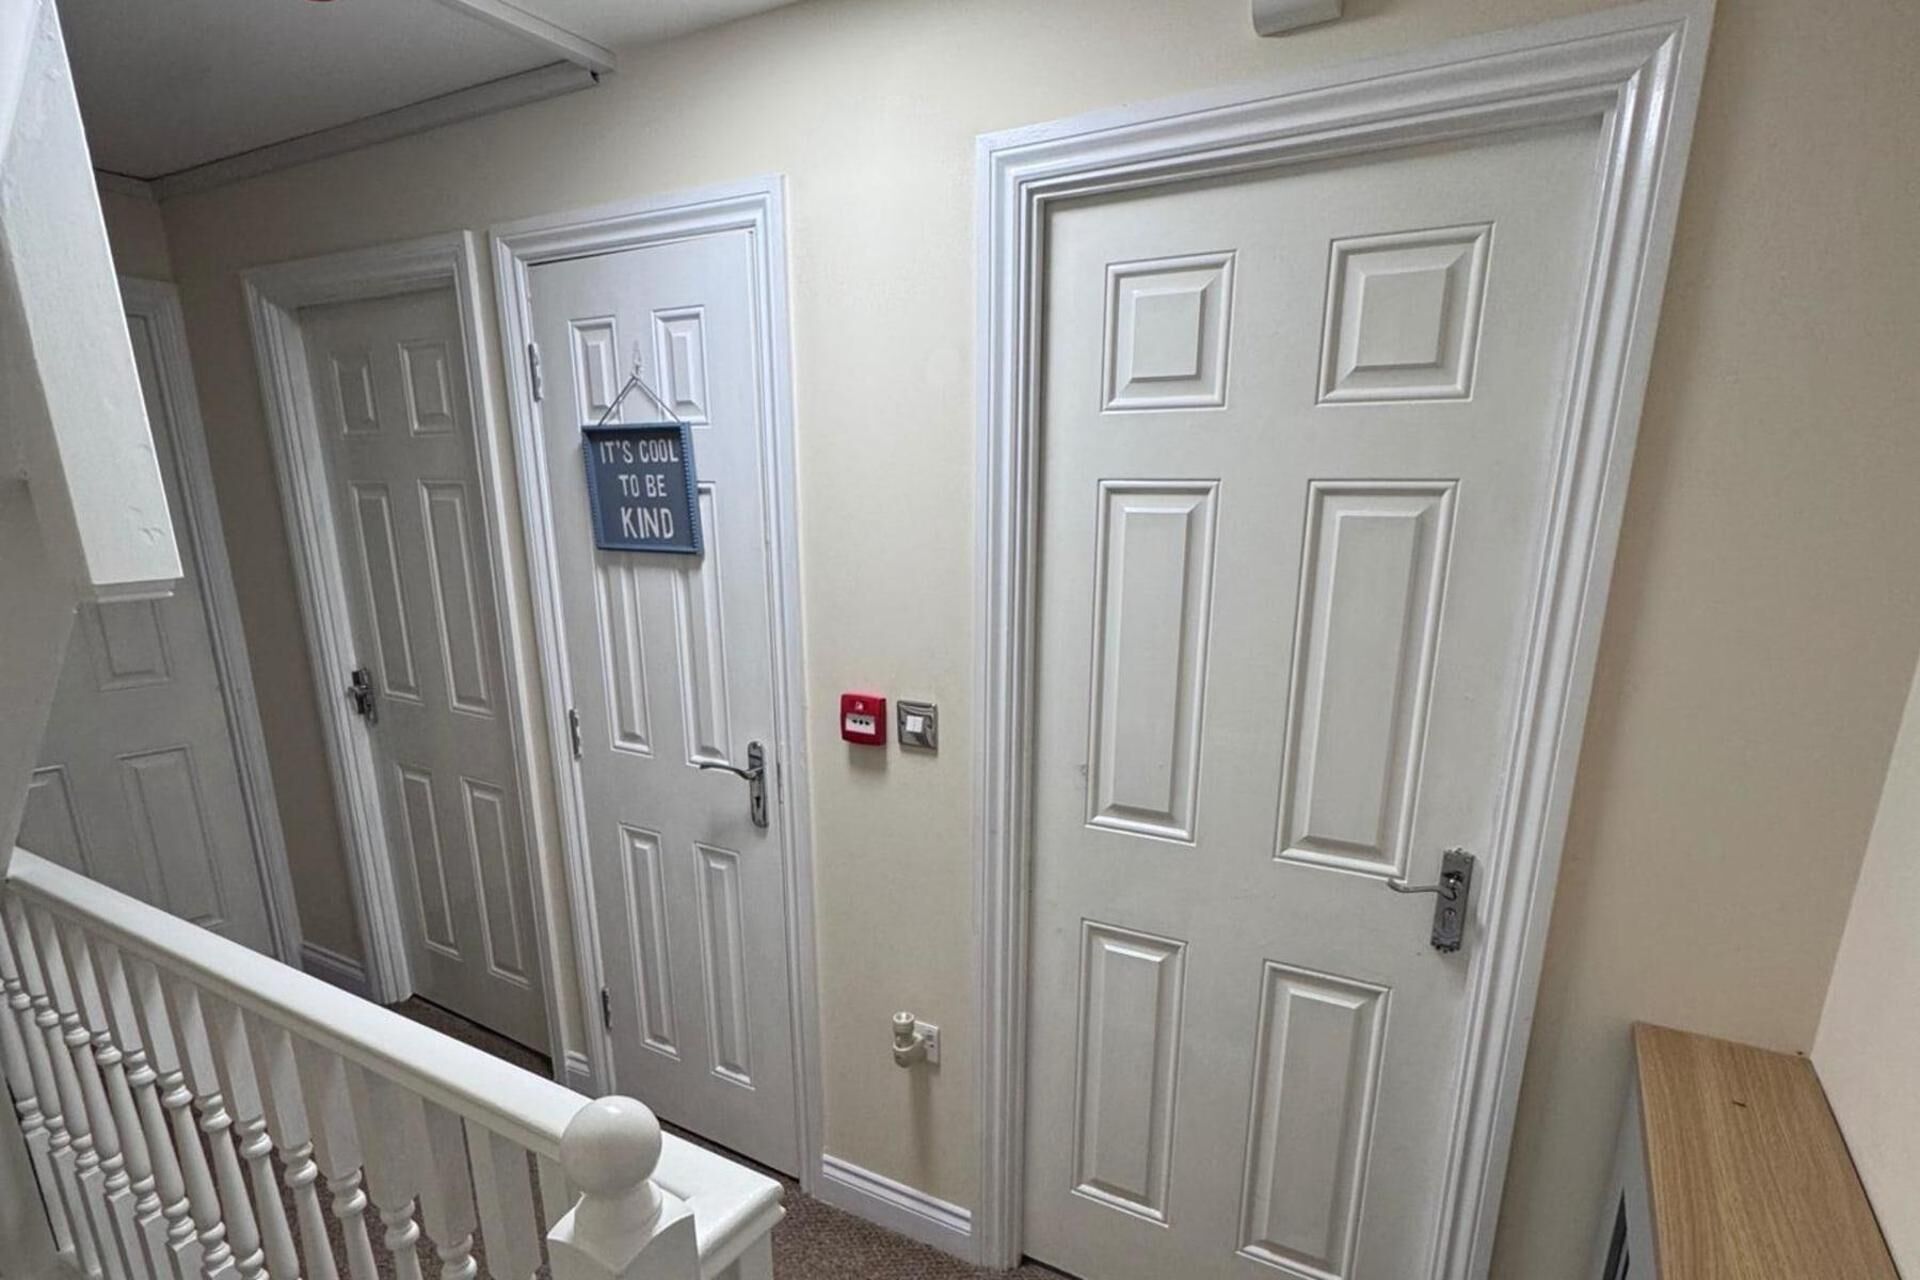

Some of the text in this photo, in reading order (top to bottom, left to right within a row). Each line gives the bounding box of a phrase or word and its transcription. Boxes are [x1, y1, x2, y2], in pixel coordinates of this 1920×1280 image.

[600, 439, 679, 464] IT'S COOL
[618, 474, 667, 497] TO BE
[620, 506, 674, 539] KIND
